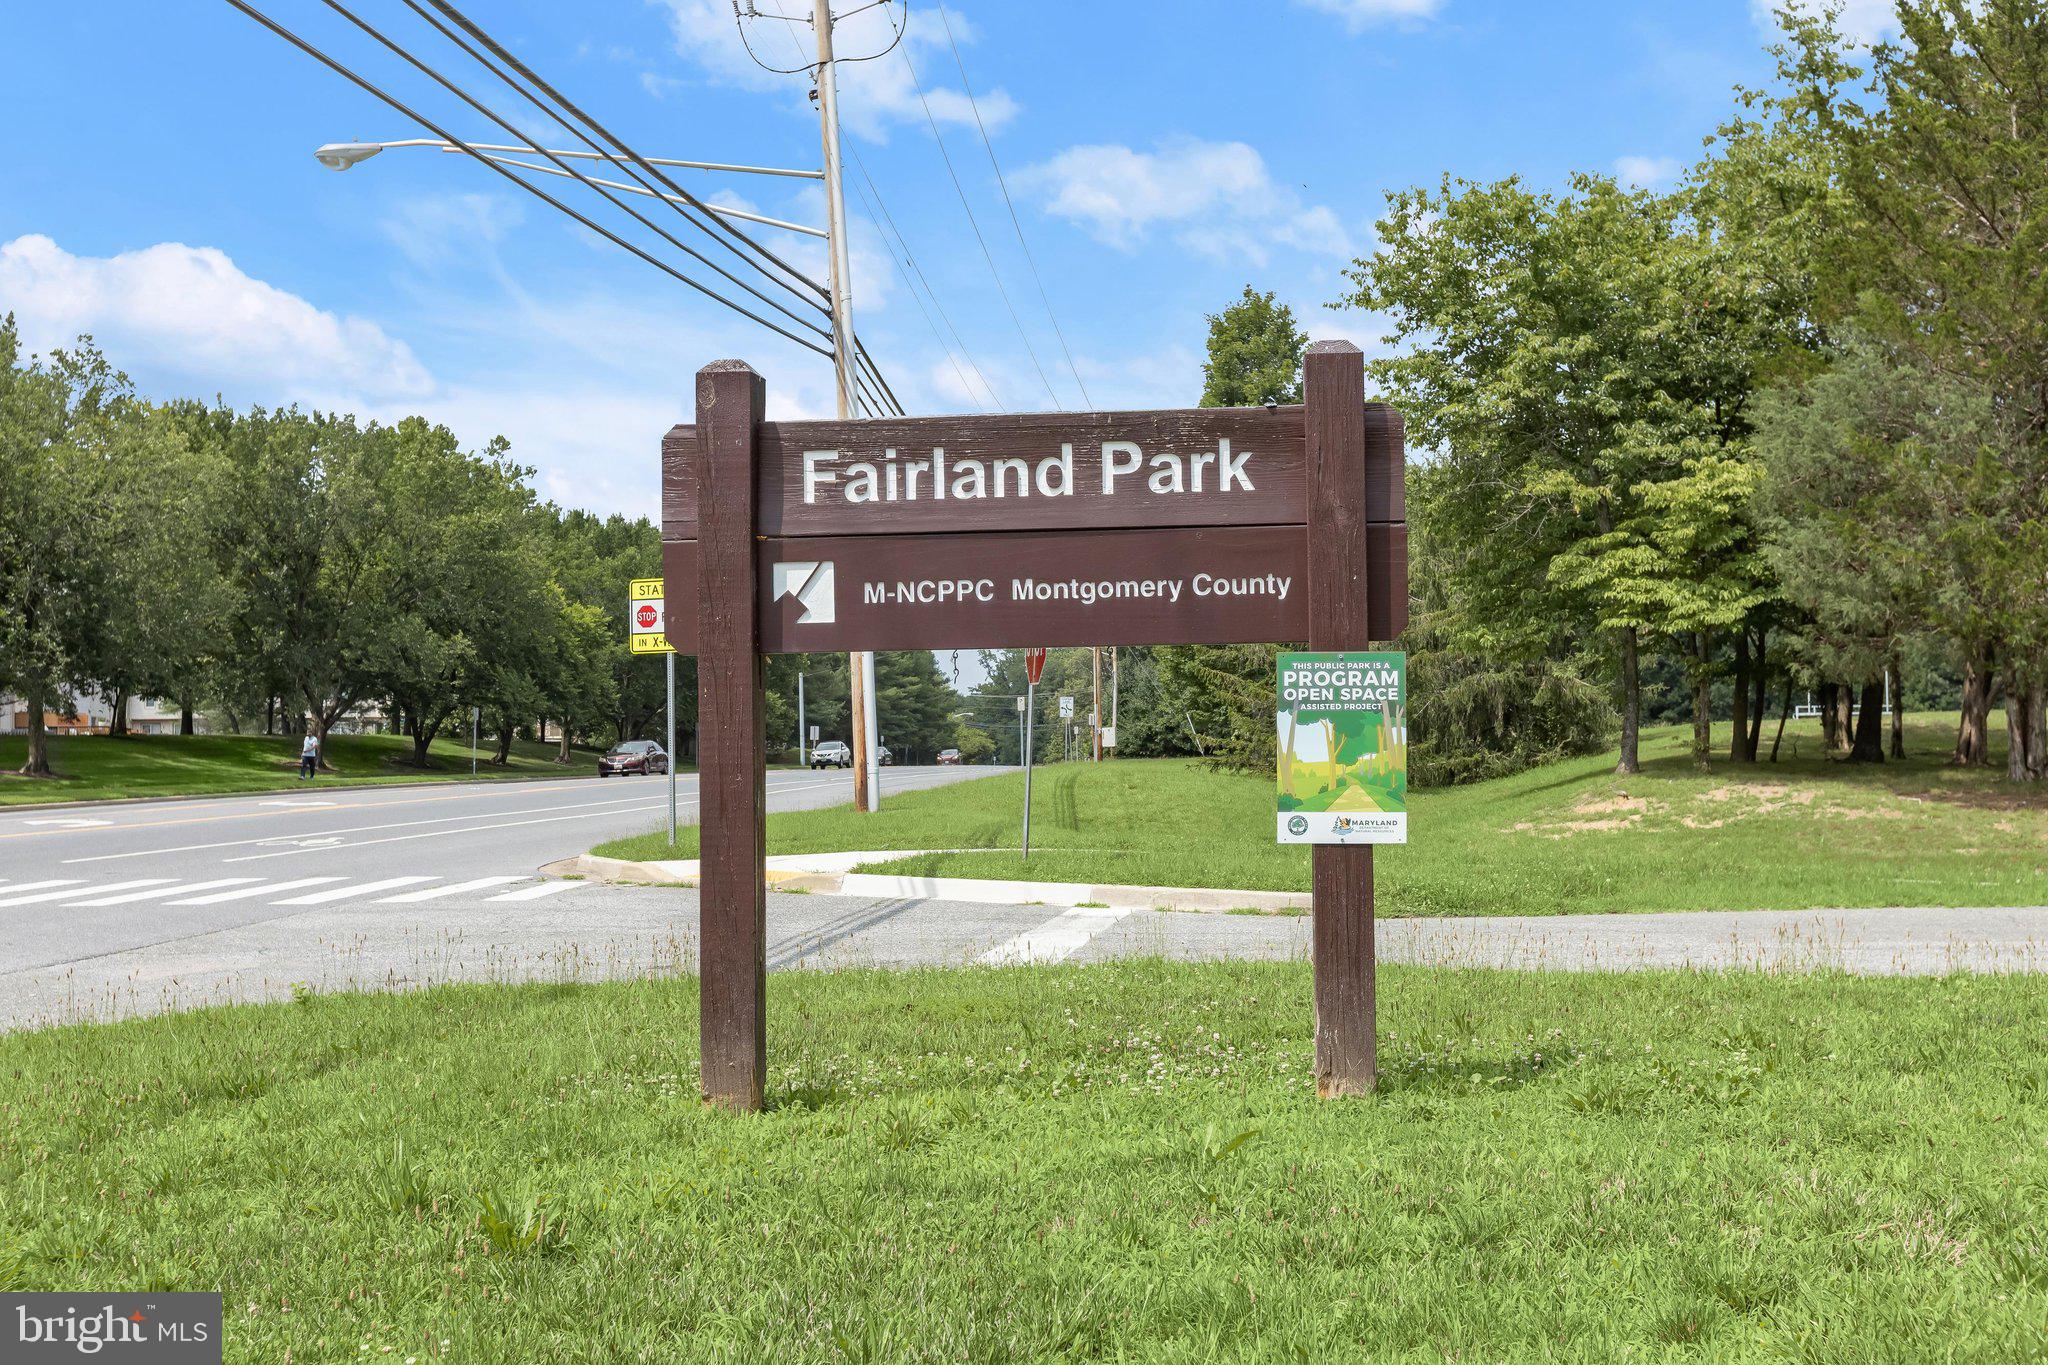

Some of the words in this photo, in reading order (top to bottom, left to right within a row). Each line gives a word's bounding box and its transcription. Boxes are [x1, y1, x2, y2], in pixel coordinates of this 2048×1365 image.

[803, 443, 1074, 503] Fairland
[1101, 438, 1256, 494] Park
[639, 585, 664, 596] STAT
[864, 579, 994, 604] M-NCPPC
[1012, 578, 1183, 605] Montgomery
[1192, 573, 1292, 600] County
[637, 612, 656, 622] STOP
[638, 639, 647, 647] IN
[1283, 671, 1399, 686] PROGRAM
[1283, 688, 1334, 701] OPEN
[1340, 688, 1399, 701] SPACE
